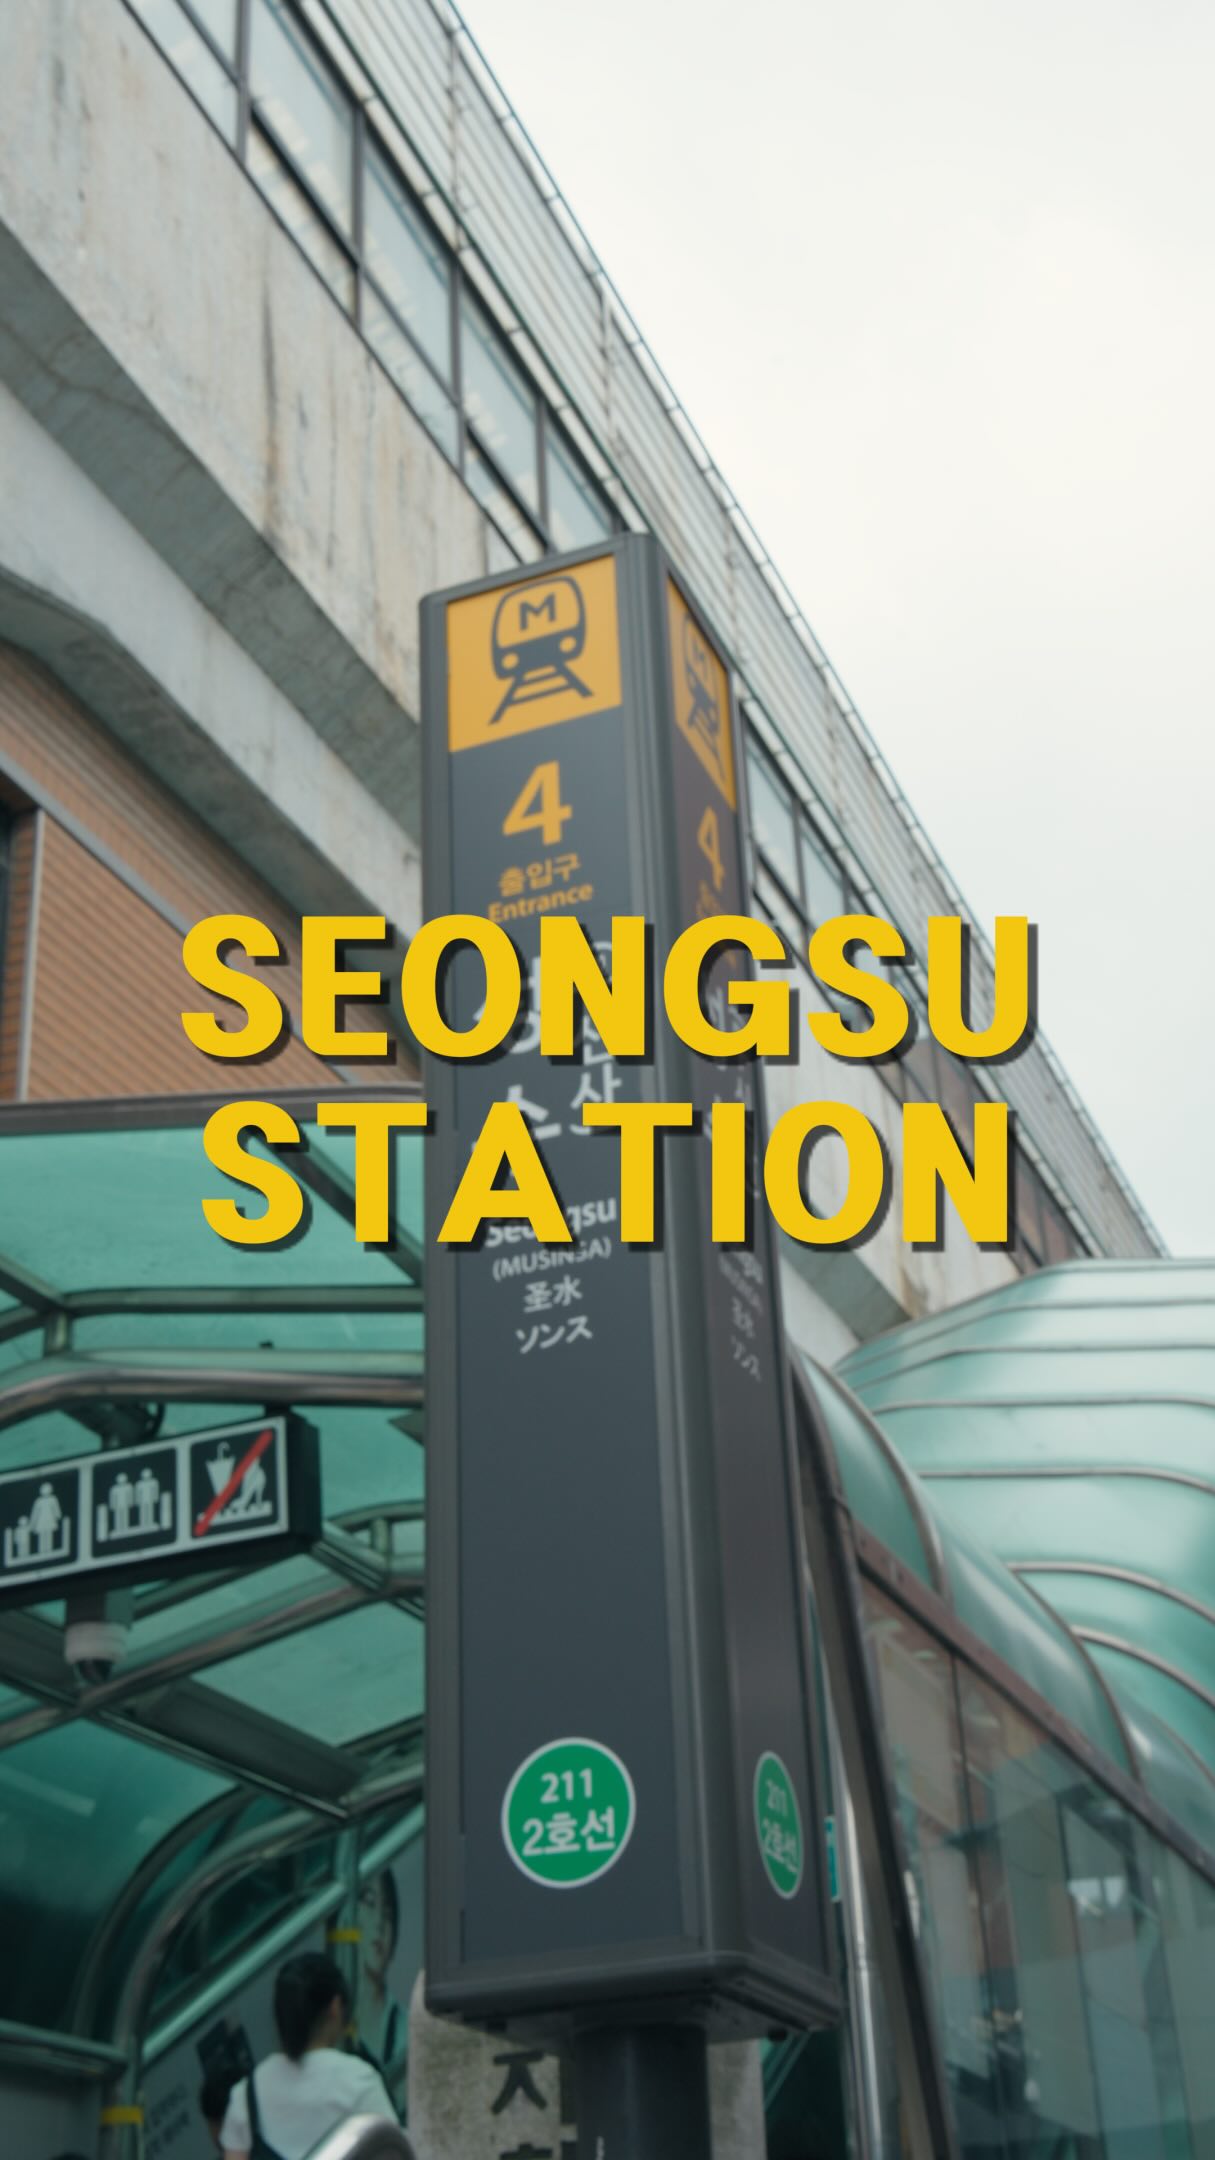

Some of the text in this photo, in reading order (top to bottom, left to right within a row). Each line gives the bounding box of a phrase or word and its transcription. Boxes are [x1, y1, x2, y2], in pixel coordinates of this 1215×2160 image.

[502, 760, 573, 847] 4
[498, 851, 582, 898] 출입구
[487, 883, 594, 923] Entrance
[514, 1314, 594, 1355] ソンス
[540, 1767, 593, 1804] 211
[522, 1805, 617, 1857] 2호선
